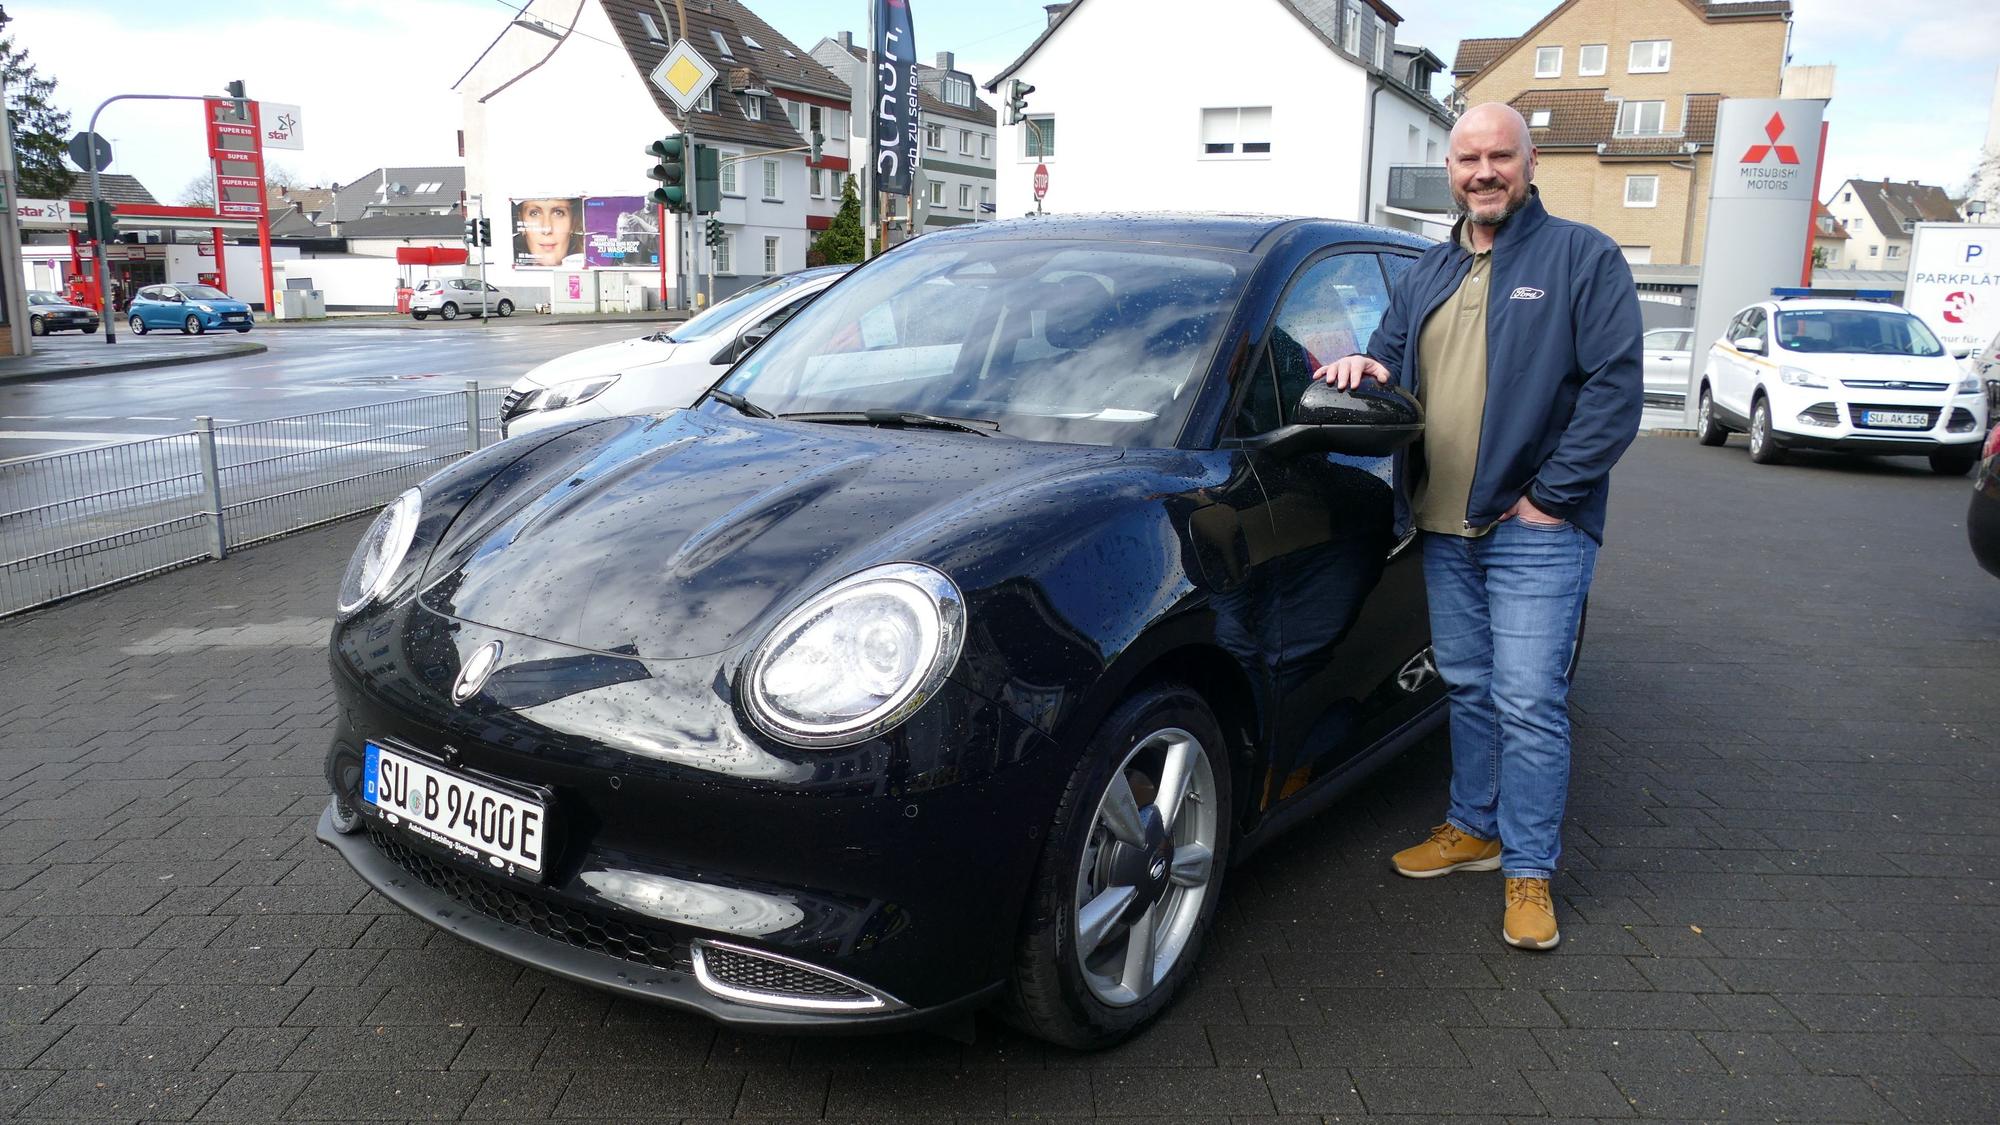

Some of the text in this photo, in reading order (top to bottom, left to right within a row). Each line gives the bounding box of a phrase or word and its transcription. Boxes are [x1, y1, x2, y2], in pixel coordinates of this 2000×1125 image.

[268, 130, 288, 141] star
[908, 122, 917, 143] zu
[1740, 167, 1799, 178] MITSUBISHI
[1034, 173, 1048, 189] STOP
[1747, 179, 1789, 190] MOTORS
[17, 206, 44, 217] star
[1965, 244, 1983, 263] P
[1511, 288, 1542, 299] Ford
[1941, 335, 1959, 344] nur
[1962, 335, 1979, 344] für
[1869, 413, 1927, 425] SU AK 156
[379, 758, 539, 862] SU B 9400E
